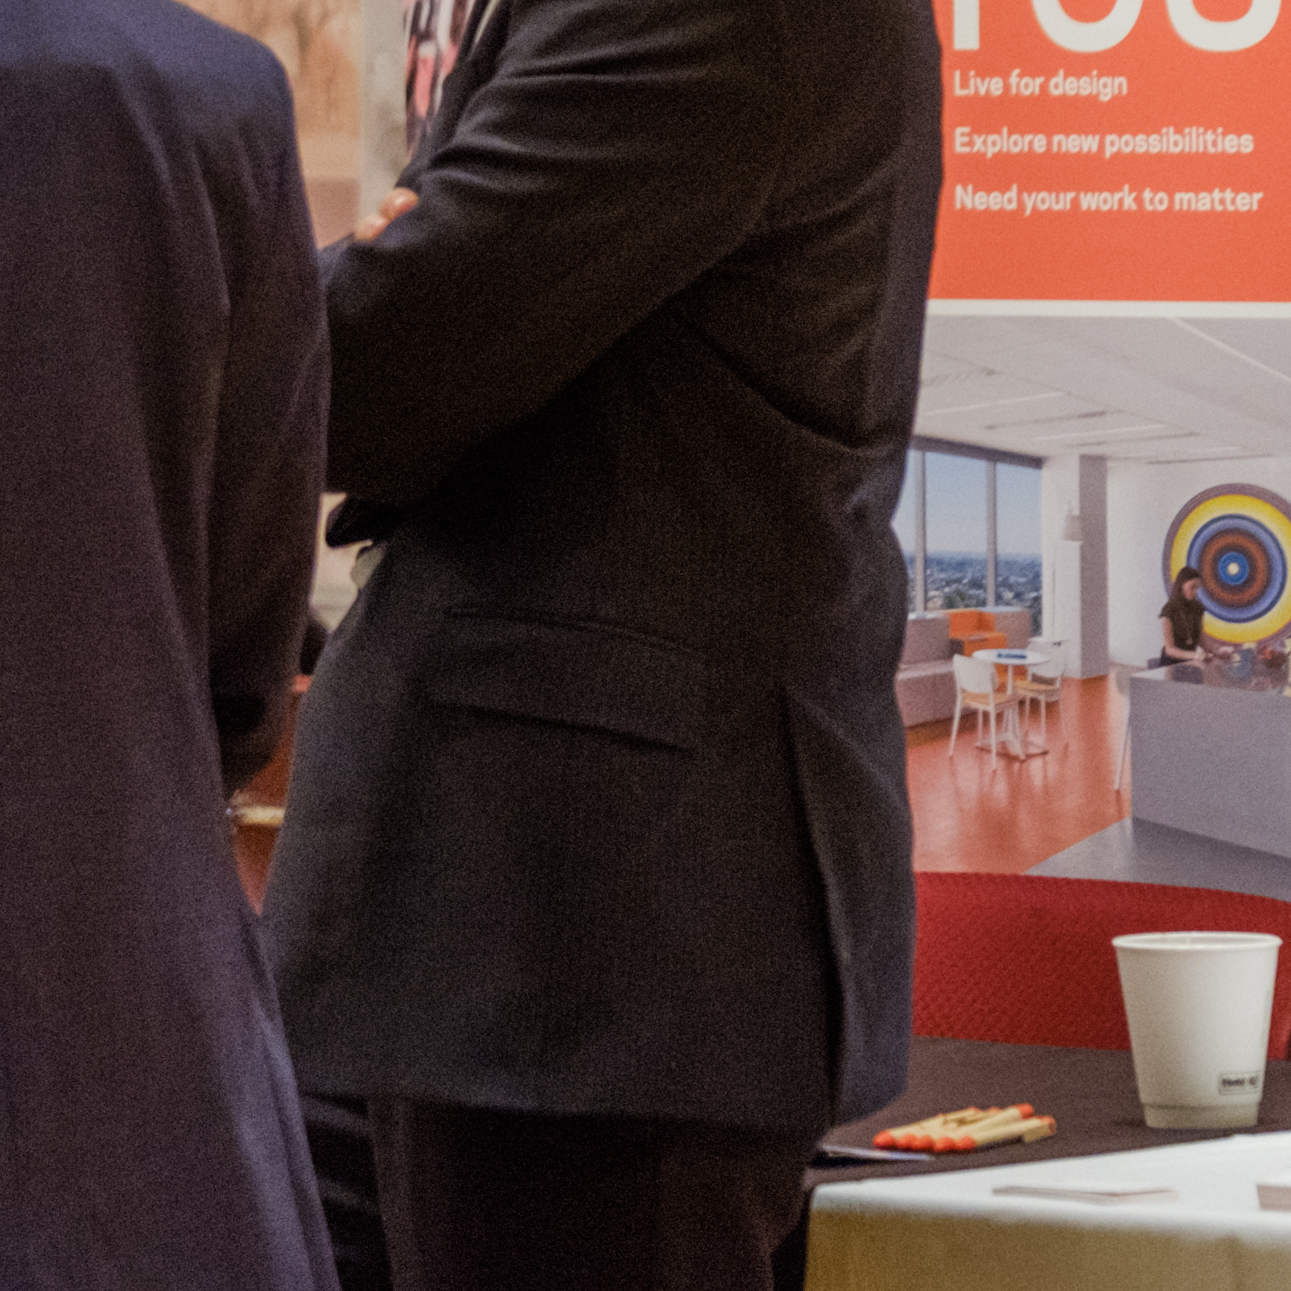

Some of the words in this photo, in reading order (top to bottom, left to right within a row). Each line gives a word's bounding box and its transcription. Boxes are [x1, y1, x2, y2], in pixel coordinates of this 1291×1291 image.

[954, 70, 1004, 96] Live
[1009, 69, 1045, 96] for
[1049, 69, 1128, 102] design
[954, 126, 1047, 159] Explore
[1052, 133, 1100, 153] new
[1105, 126, 1254, 159] possibilities
[954, 184, 1018, 210] Need
[1023, 191, 1076, 217] your
[1079, 184, 1137, 210] work
[1142, 187, 1169, 210] to
[1174, 187, 1263, 210] matter
